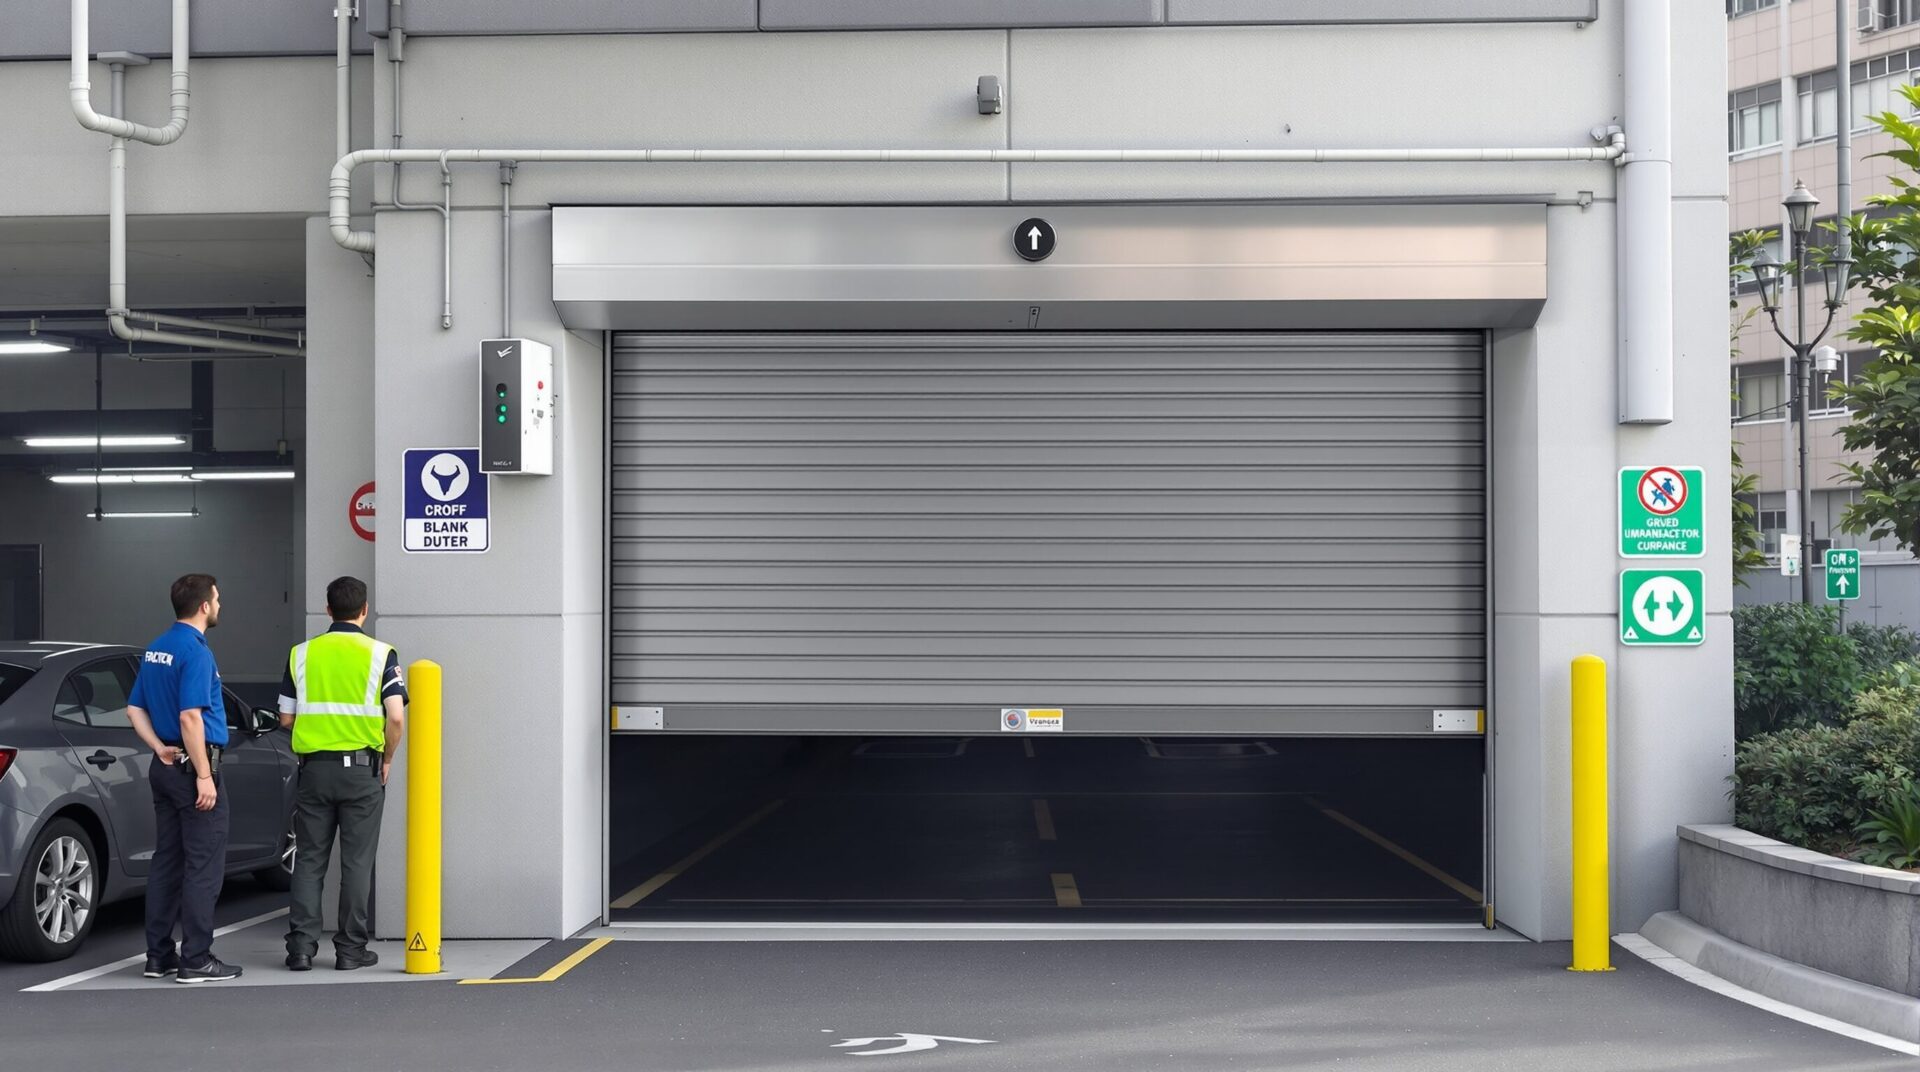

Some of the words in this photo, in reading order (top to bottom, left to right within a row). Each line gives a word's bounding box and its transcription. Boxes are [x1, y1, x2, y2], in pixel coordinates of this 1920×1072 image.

[425, 504, 467, 516] CROFF
[424, 521, 468, 533] BLANK
[424, 536, 468, 547] DUTER
